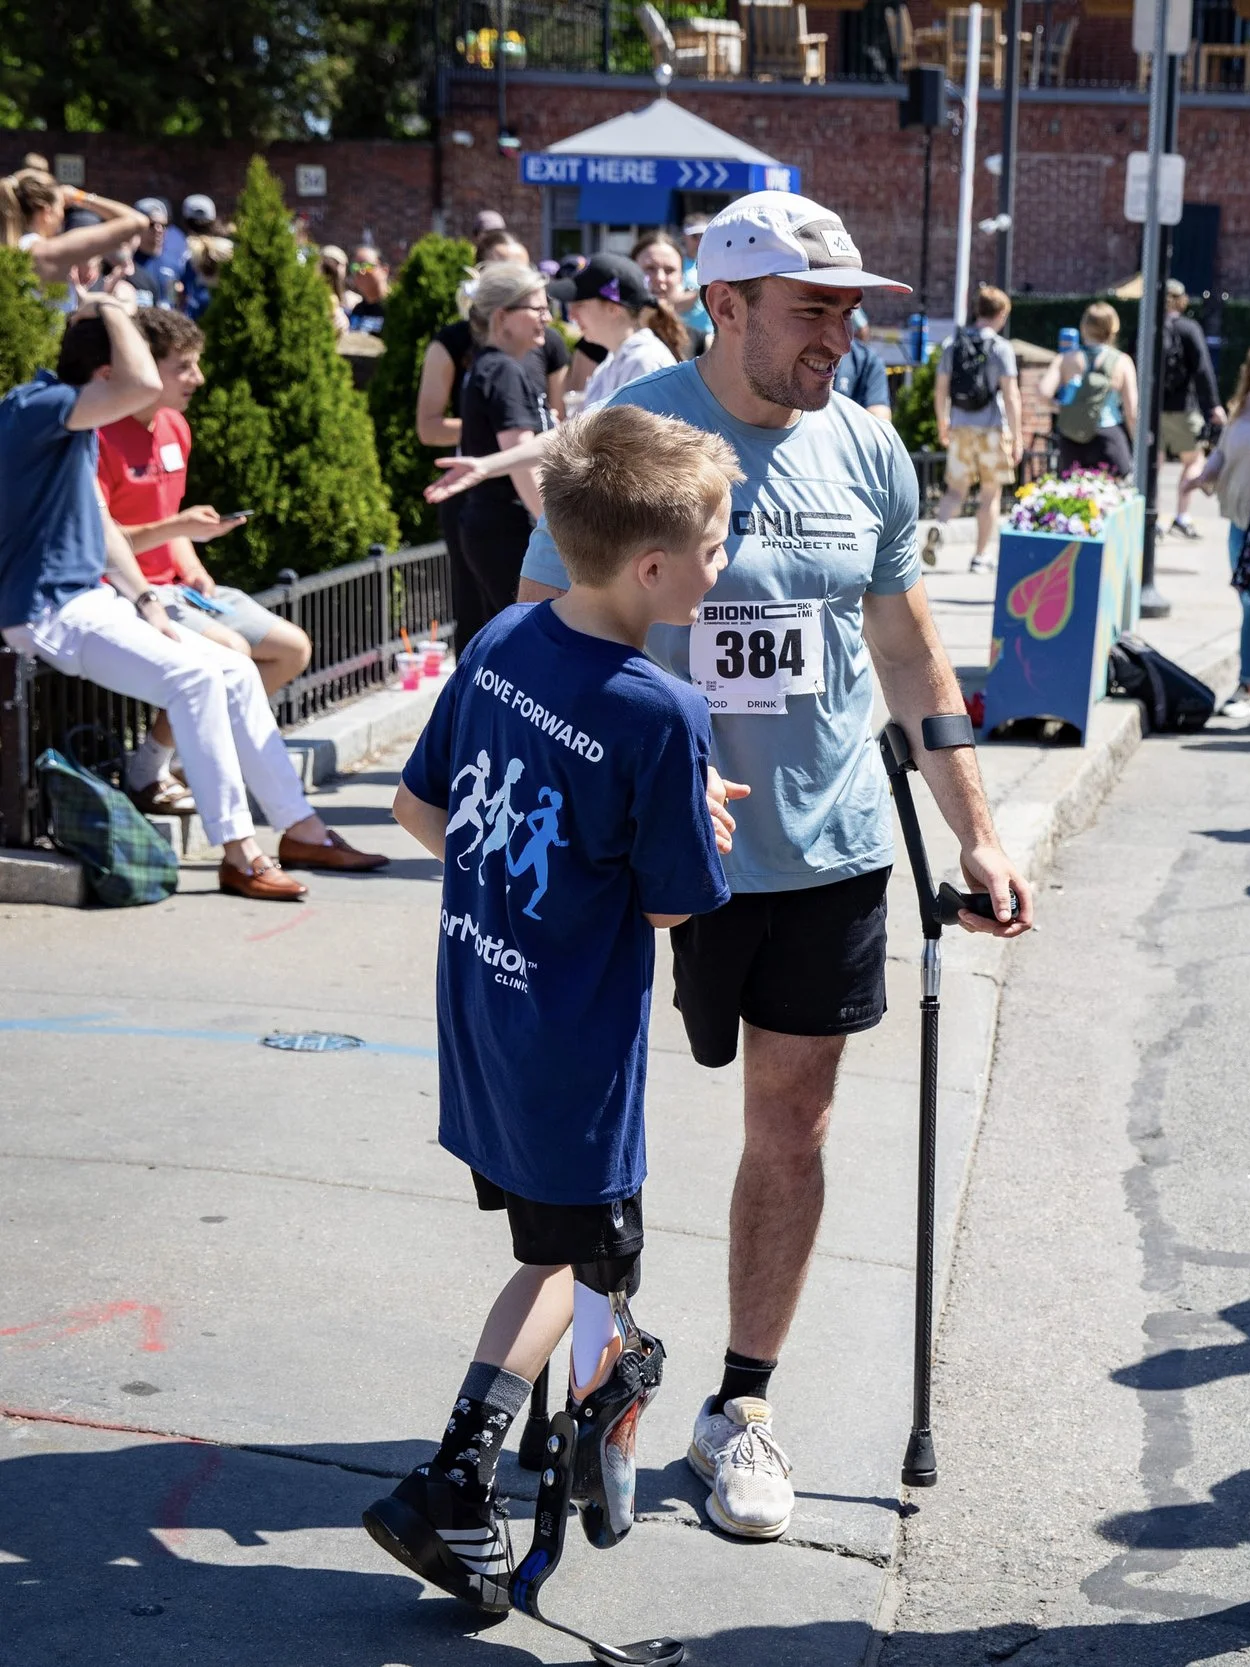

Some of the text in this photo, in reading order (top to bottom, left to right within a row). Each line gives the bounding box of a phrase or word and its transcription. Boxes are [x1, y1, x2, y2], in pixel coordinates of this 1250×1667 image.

[525, 158, 658, 185] EXIT HERE
[731, 510, 857, 539] ONIC
[761, 540, 859, 552] PROJECT INC
[703, 603, 797, 621] BIONIC
[715, 628, 805, 679] 384
[707, 700, 777, 709] OOD DRINK
[510, 689, 605, 763] FORWARD
